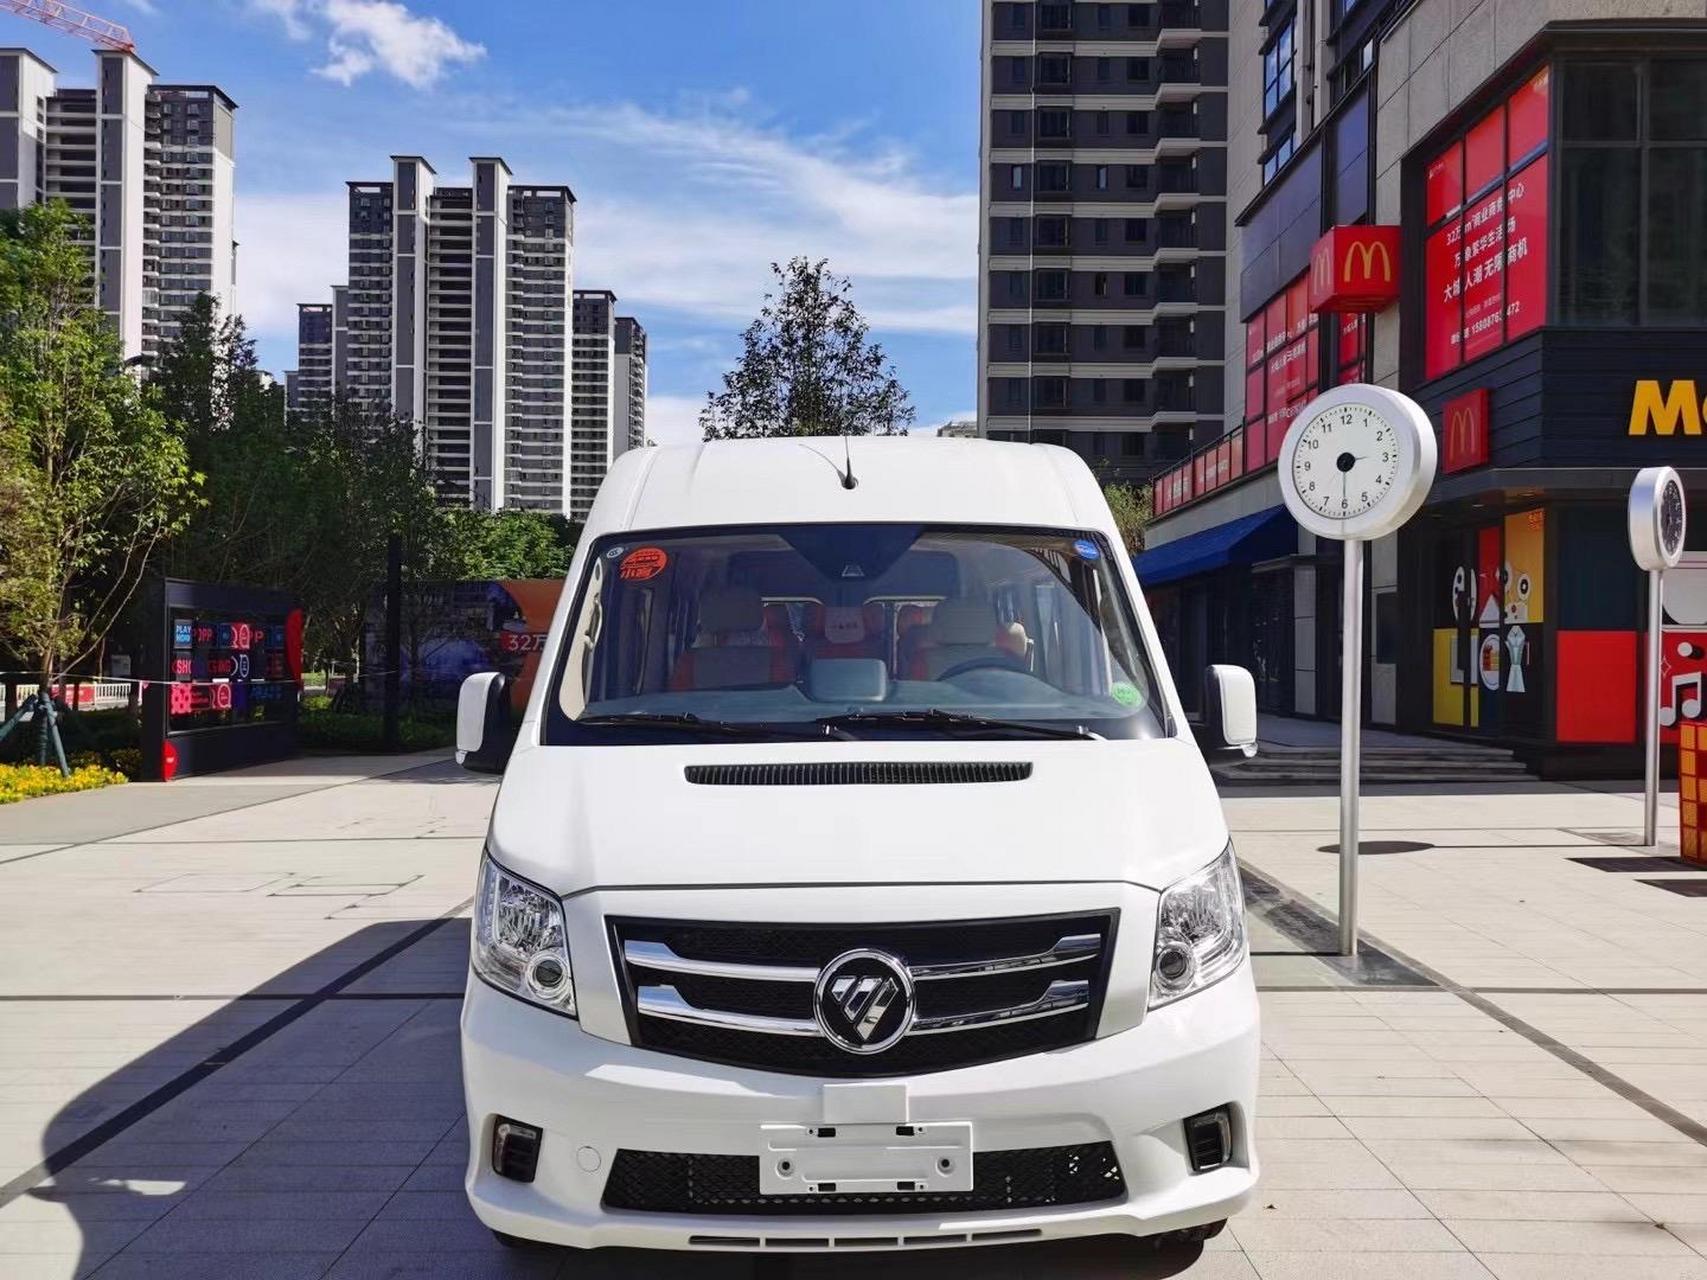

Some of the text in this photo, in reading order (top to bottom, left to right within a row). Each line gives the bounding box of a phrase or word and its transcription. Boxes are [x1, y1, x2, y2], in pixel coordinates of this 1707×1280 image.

[1628, 379, 1707, 436] M
[1340, 414, 1353, 426] 12
[1363, 418, 1368, 427] 1
[1321, 423, 1332, 433] 11
[1376, 430, 1384, 442] 2
[1307, 439, 1319, 450] 10
[1382, 452, 1389, 463] 3
[1304, 461, 1311, 471] 9
[1375, 474, 1382, 484] 4
[1309, 481, 1316, 491] 8
[1323, 496, 1330, 506] 7
[1361, 491, 1368, 502] 5
[1341, 499, 1348, 509] 6
